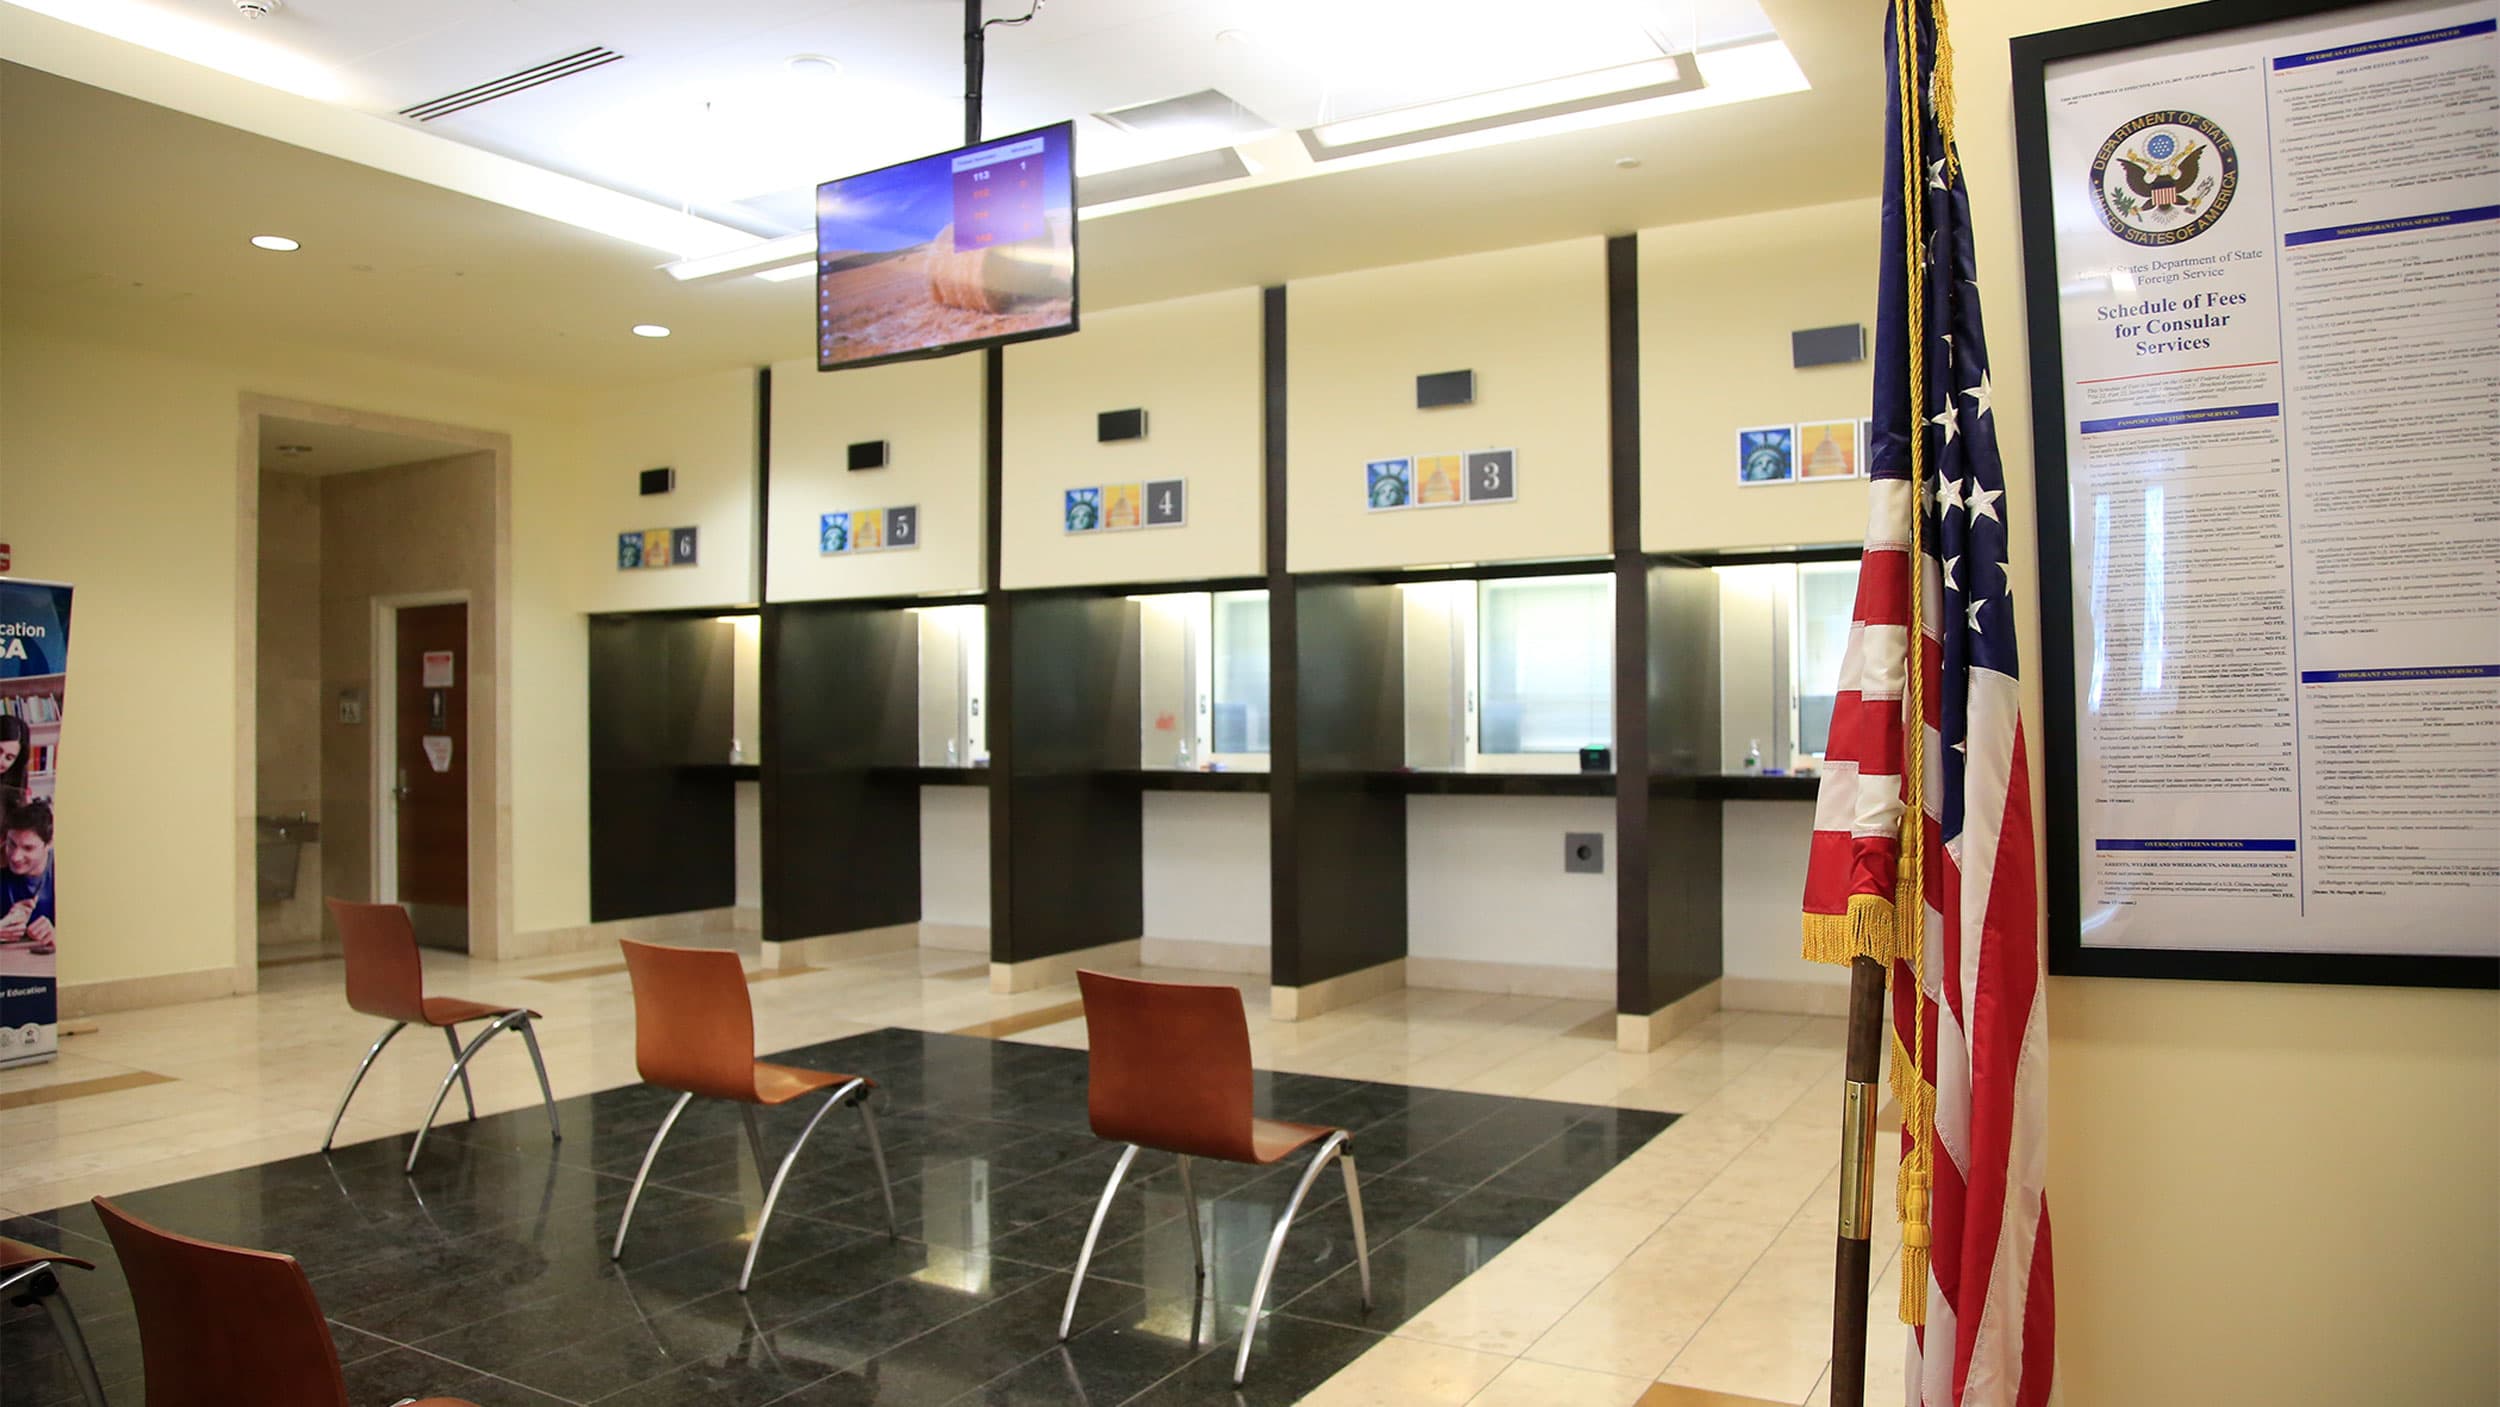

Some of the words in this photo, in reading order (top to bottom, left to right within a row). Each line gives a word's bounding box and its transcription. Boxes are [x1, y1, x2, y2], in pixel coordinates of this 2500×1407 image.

[2094, 111, 2176, 171] DEPARTMENT
[2178, 112, 2198, 126] OF
[2199, 119, 2233, 153] STATE
[973, 170, 990, 181] 113
[1020, 161, 1026, 171] 1
[2125, 228, 2176, 245] STATES
[2176, 225, 2197, 241] OF
[2197, 169, 2237, 232] AMERICA
[2152, 255, 2217, 271] Department
[2219, 251, 2233, 263] of
[2235, 249, 2263, 261] State
[2137, 271, 2180, 286] Foreign
[2183, 268, 2225, 280] Service
[2097, 297, 2177, 321] Schedule
[2182, 294, 2202, 310] of
[2207, 291, 2247, 308] Fees
[2115, 323, 2141, 339] for
[2146, 313, 2231, 335] Consular
[2136, 336, 2211, 356] Services
[1482, 462, 1500, 490] 3
[1158, 489, 1174, 515] 4
[896, 515, 909, 539] 5
[680, 535, 690, 557] 6
[0, 621, 46, 638] cation
[7, 986, 47, 998] Education
